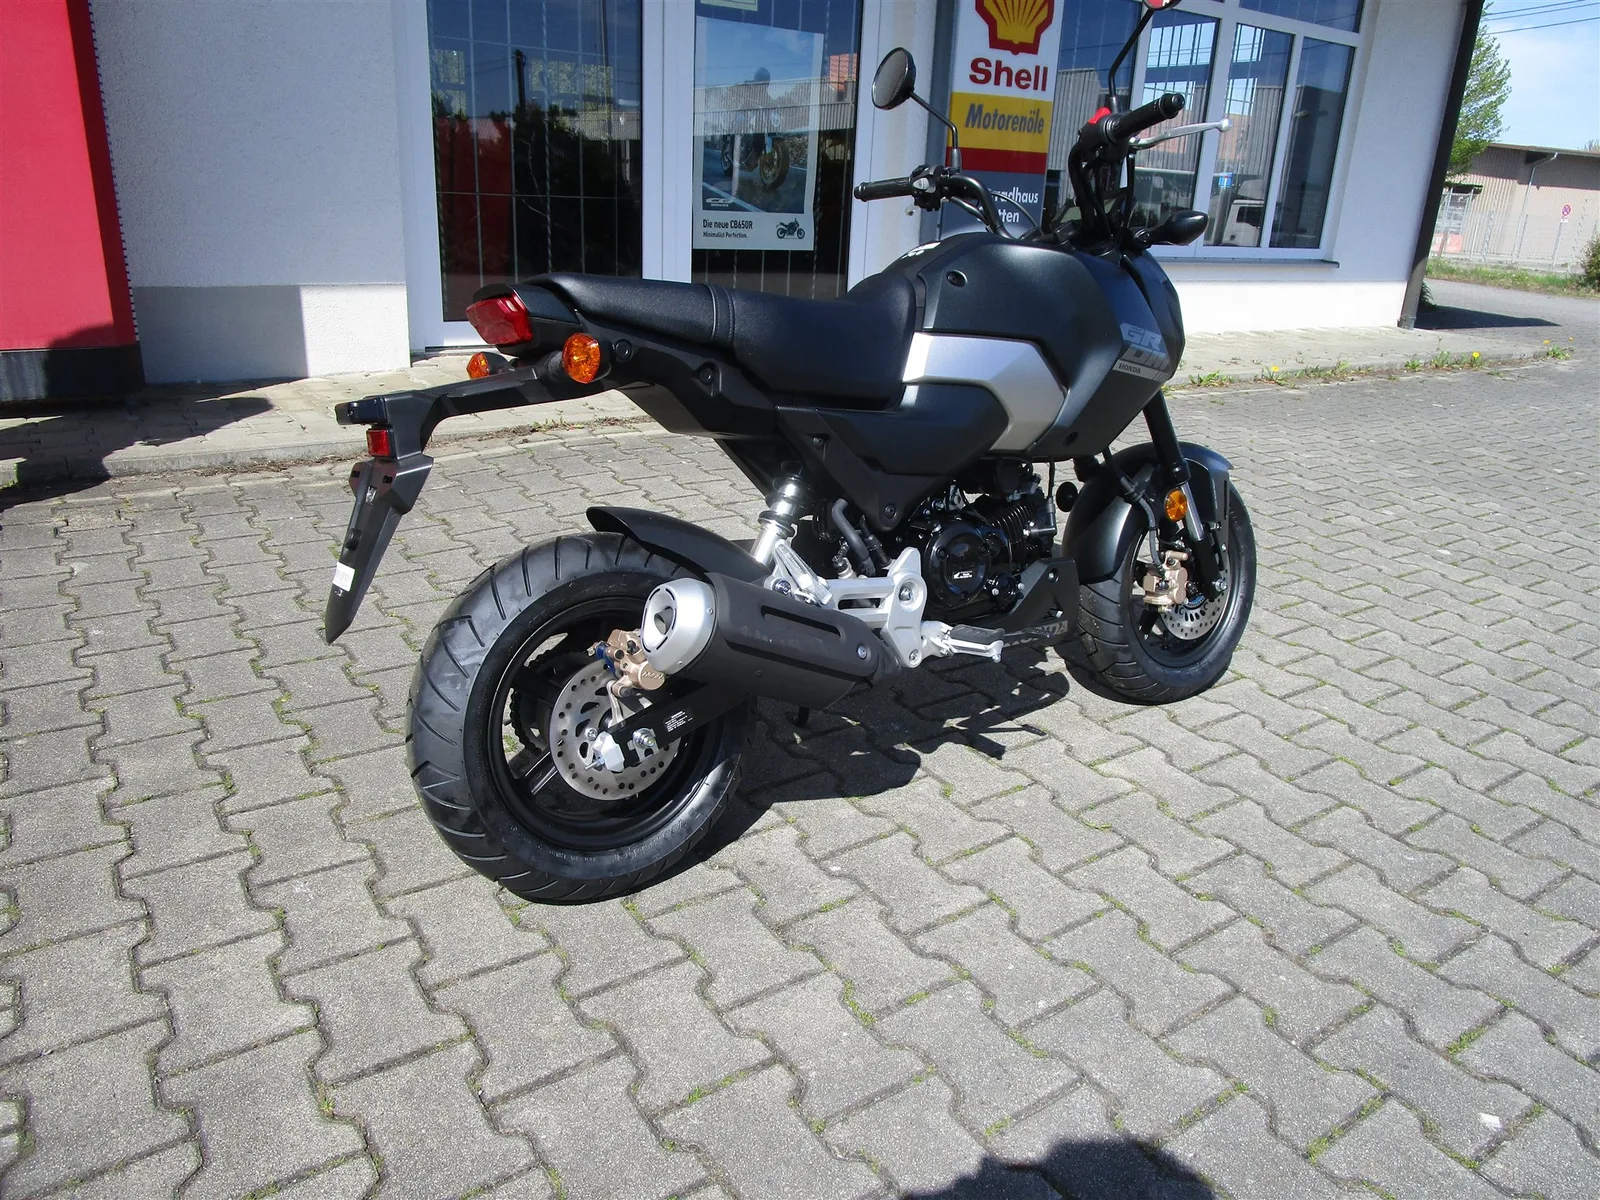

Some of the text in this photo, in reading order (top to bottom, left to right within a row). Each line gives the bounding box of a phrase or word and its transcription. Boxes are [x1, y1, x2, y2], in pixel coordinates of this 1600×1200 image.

[969, 57, 1048, 92] Shell
[965, 103, 1045, 135] Motorenöle
[703, 219, 712, 228] Die
[730, 220, 753, 229] CB650R
[1118, 363, 1141, 374] HONDA
